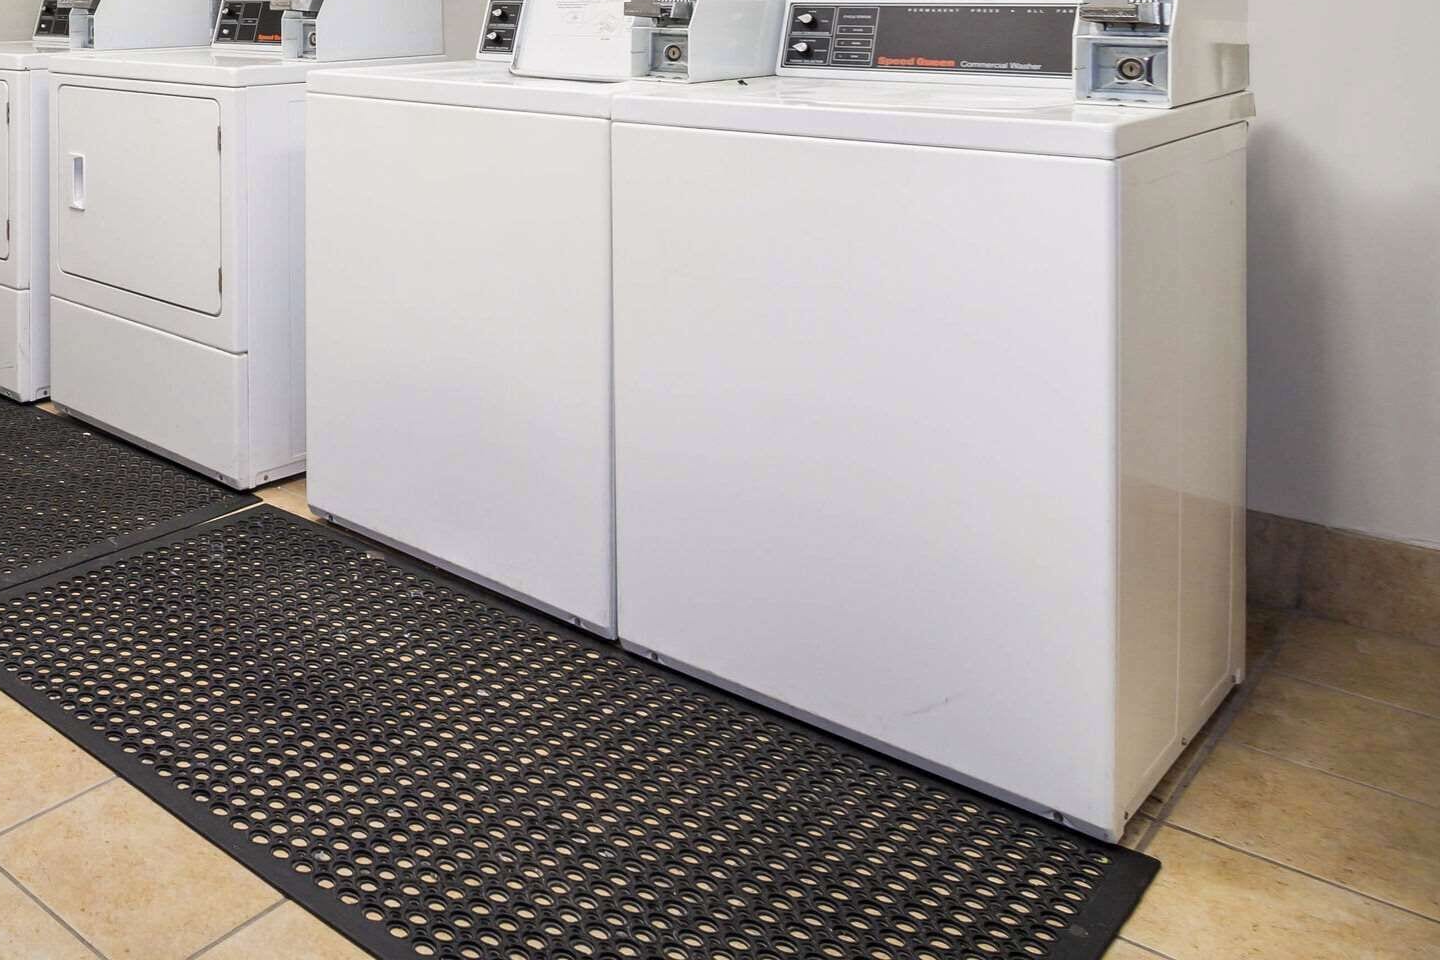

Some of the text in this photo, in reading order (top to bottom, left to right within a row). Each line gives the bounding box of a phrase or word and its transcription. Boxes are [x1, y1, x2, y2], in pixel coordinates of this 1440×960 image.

[877, 56, 1042, 70] Speed Queen Commercial Washer
